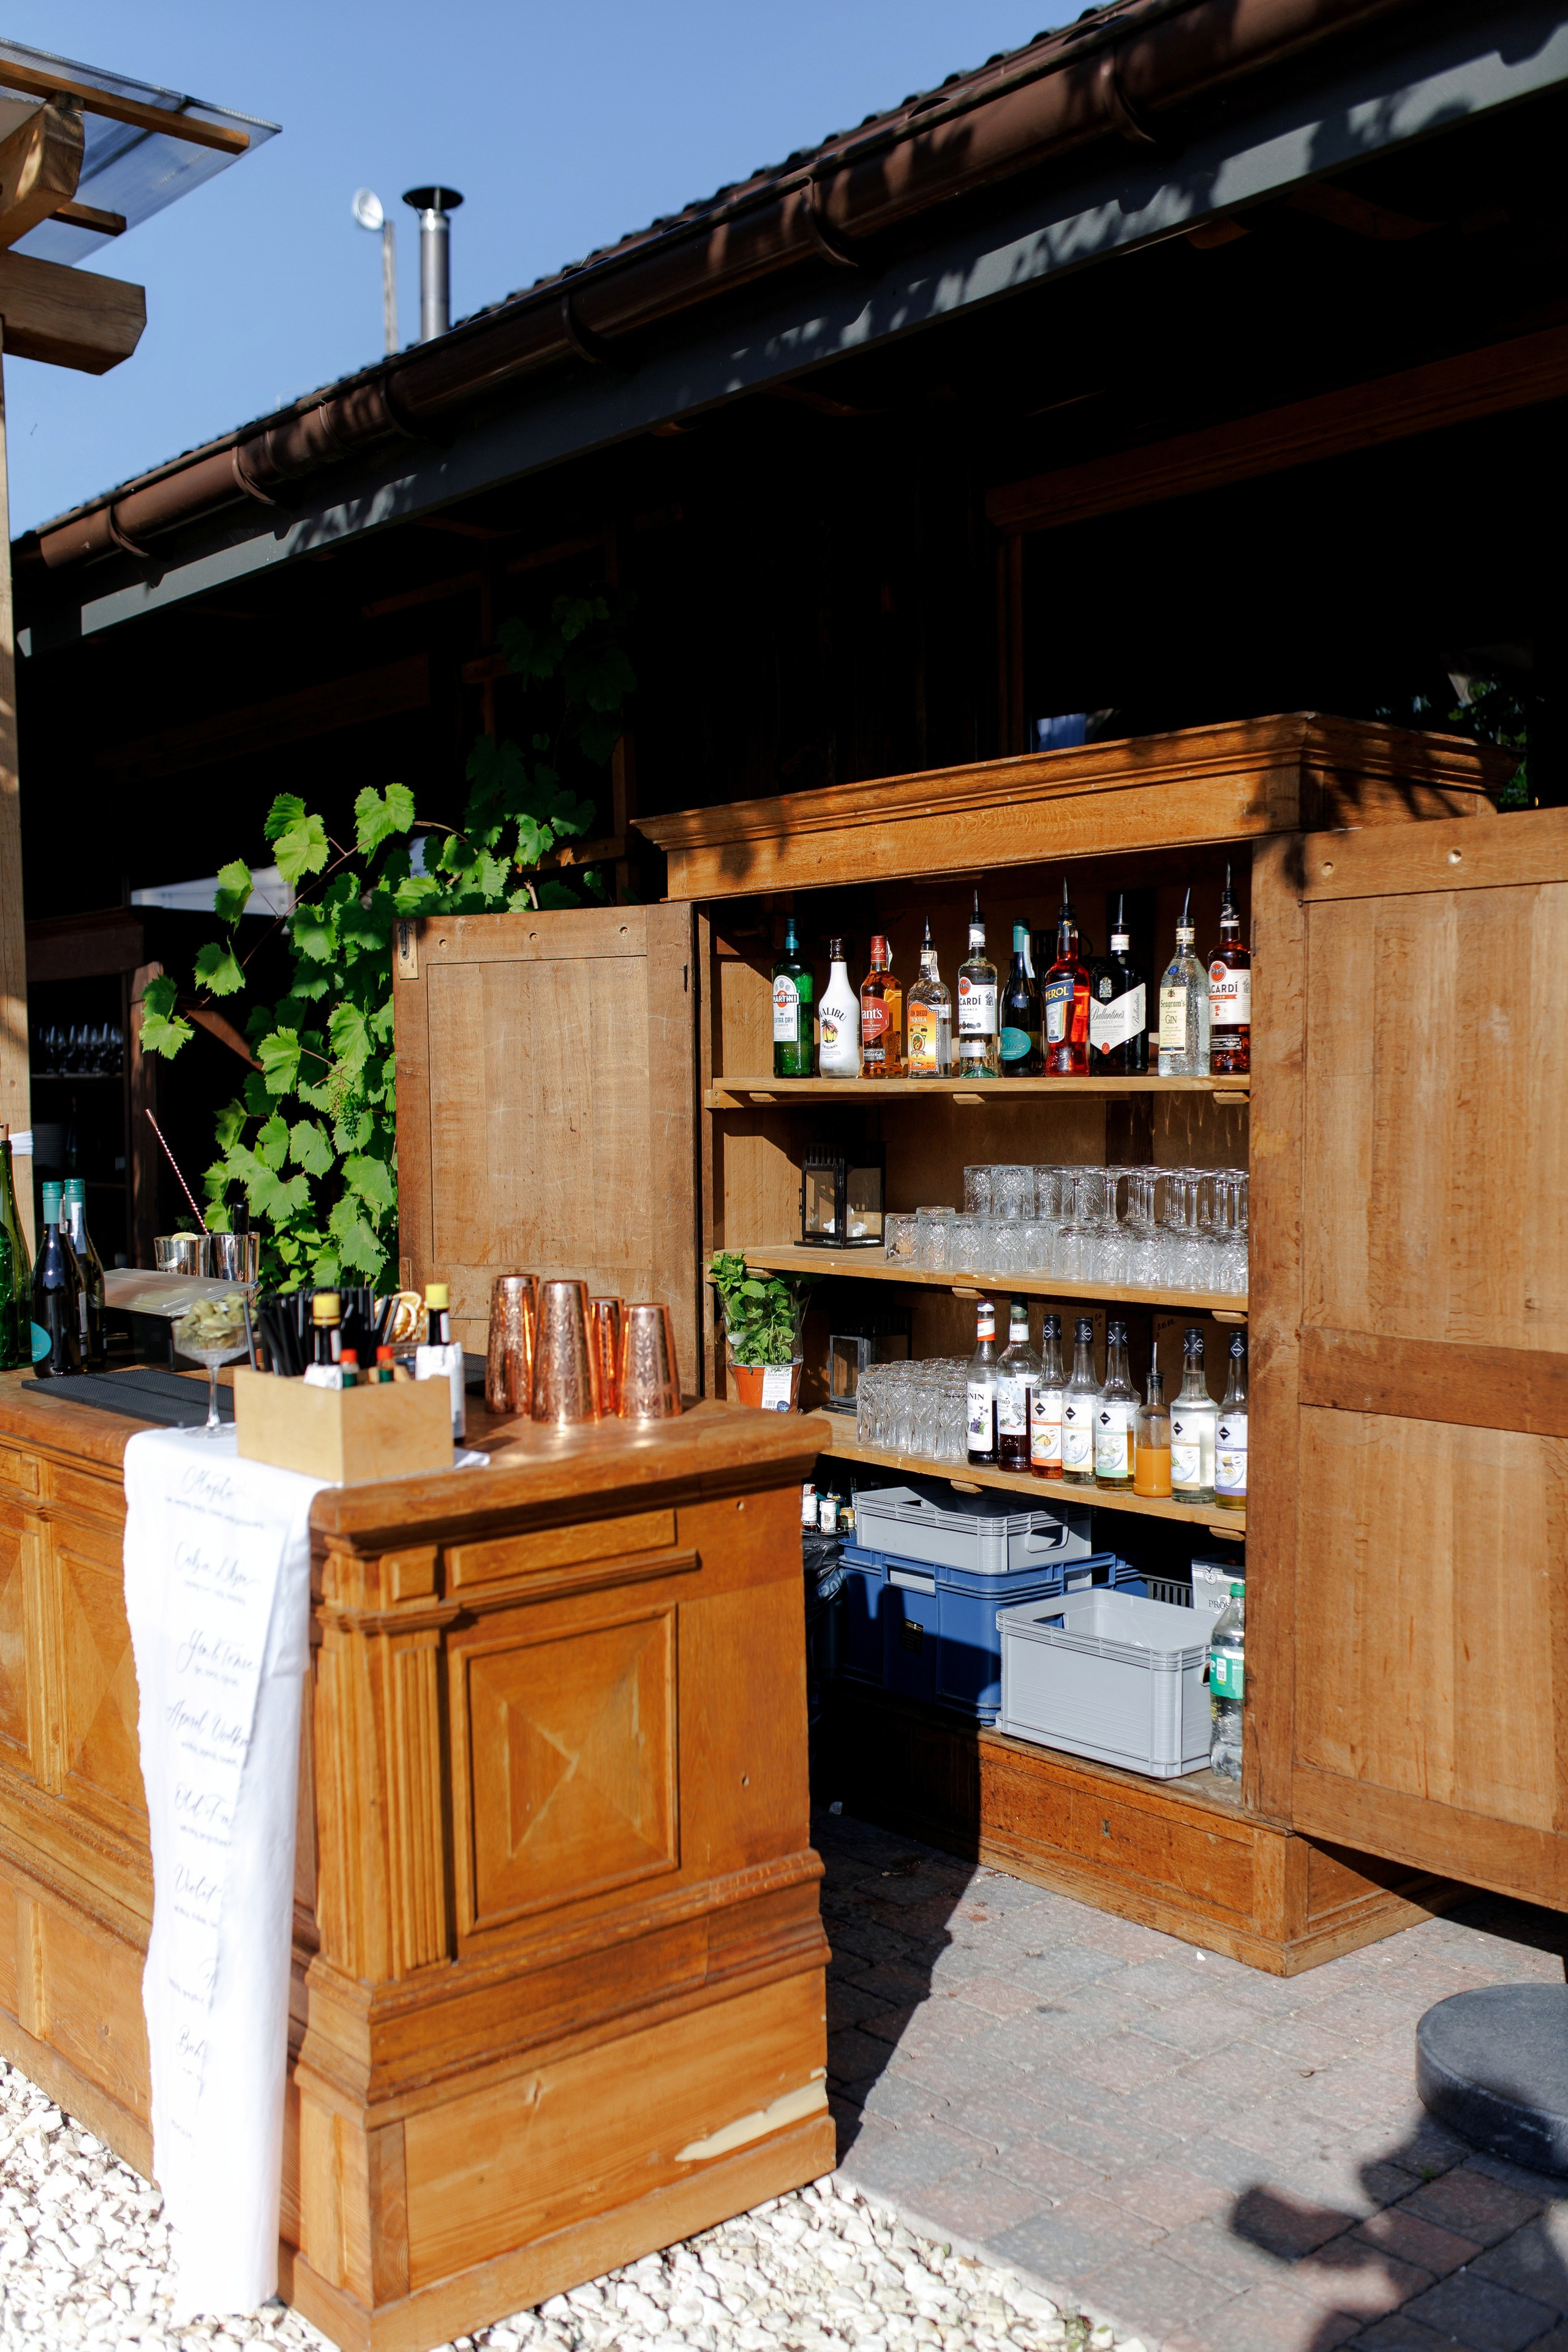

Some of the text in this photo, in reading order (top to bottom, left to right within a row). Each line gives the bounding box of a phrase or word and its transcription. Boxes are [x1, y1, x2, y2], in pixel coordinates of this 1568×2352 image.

[959, 995, 981, 1006] CARDÍ
[1160, 1000, 1186, 1009] Seagram's
[862, 1008, 883, 1019] ant's
[1090, 1006, 1125, 1021] Ballantine's
[1165, 1015, 1177, 1024] GIN
[174, 1863, 222, 1905] Violet
